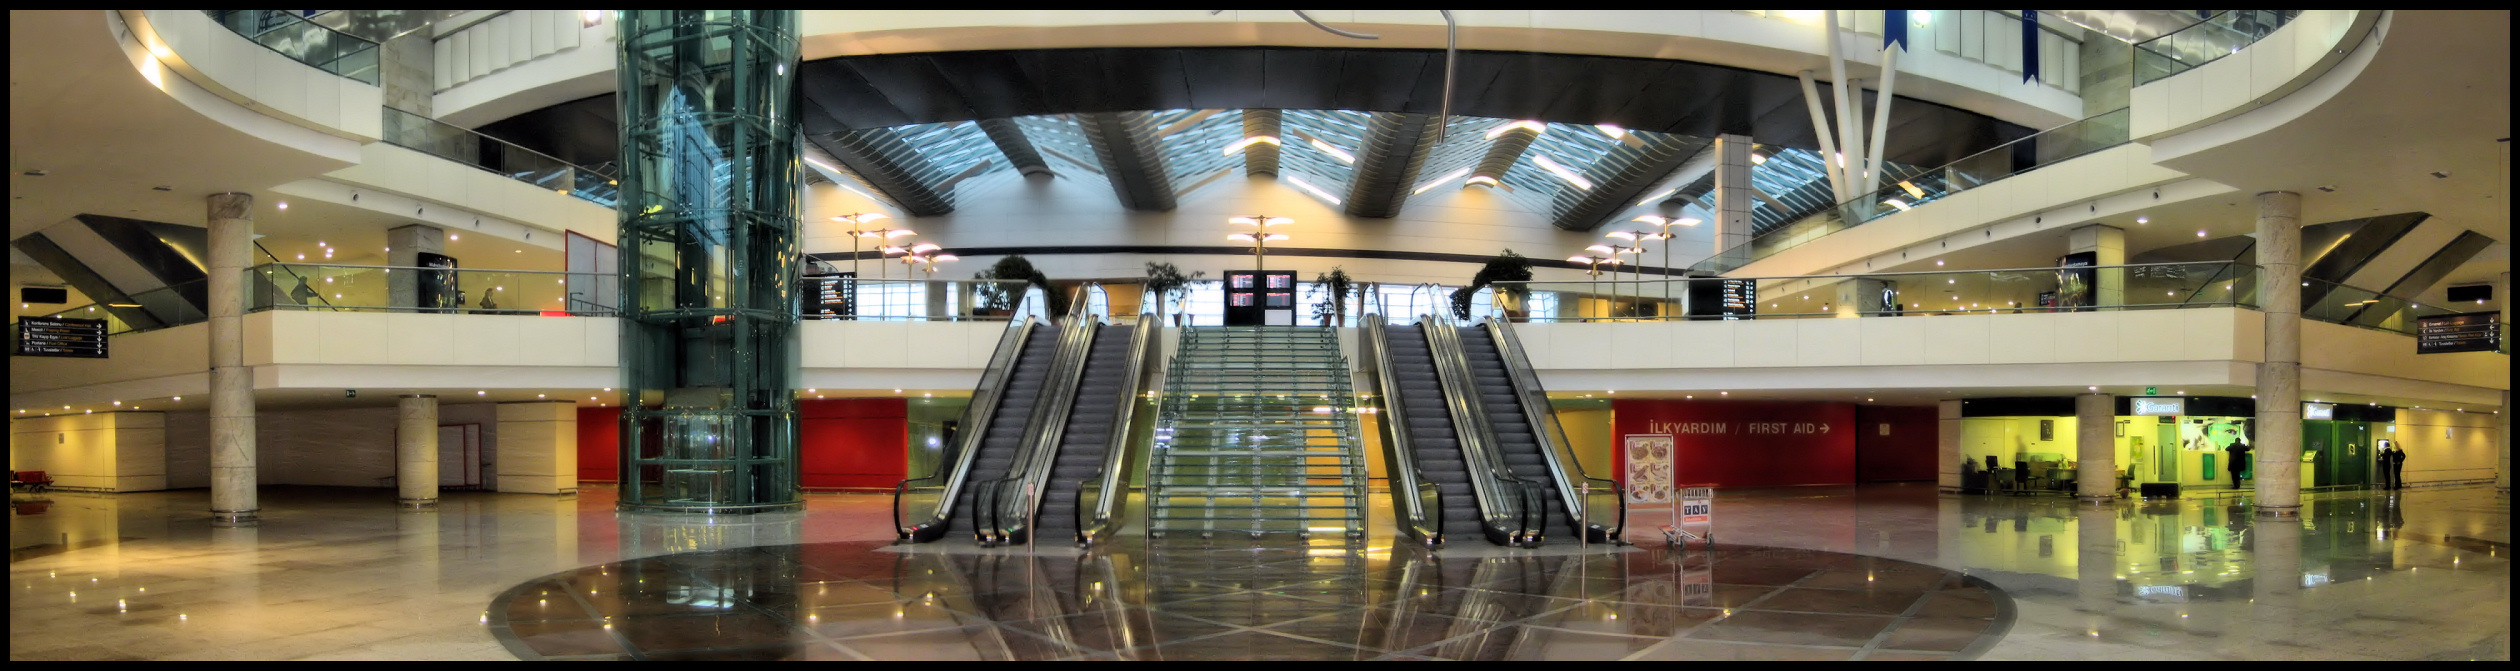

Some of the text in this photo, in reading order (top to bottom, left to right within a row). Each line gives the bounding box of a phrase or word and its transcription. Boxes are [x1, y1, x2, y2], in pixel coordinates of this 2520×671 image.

[2146, 402, 2179, 412] Garanti
[1650, 419, 1727, 434] İLKYARDIM
[1749, 422, 1787, 434] FIRST
[1793, 422, 1815, 434] AID
